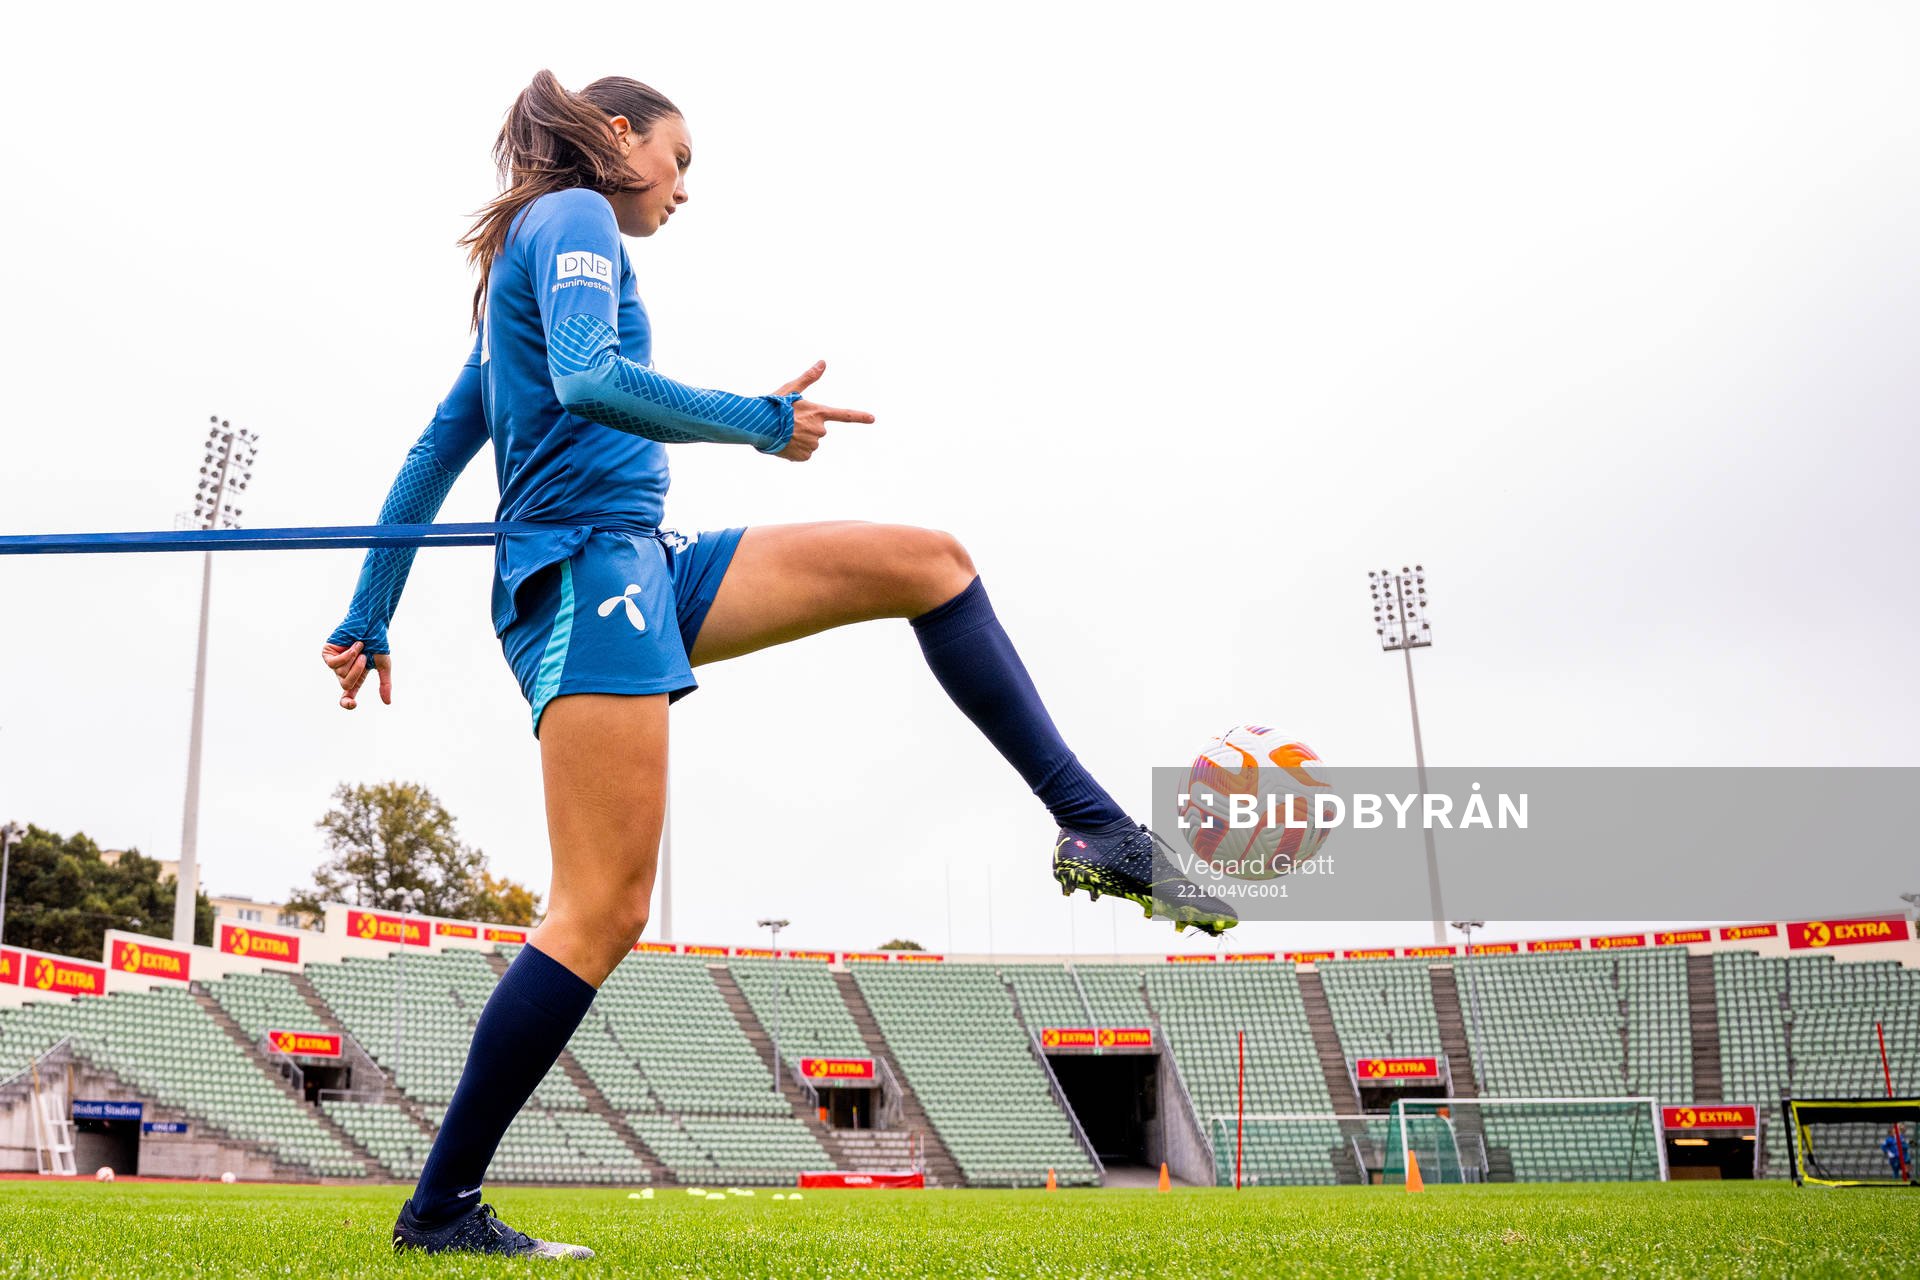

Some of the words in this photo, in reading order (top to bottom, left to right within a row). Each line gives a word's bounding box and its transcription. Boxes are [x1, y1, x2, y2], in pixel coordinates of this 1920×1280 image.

[565, 253, 607, 276] DNB
[379, 921, 420, 939] EXTRA
[1741, 926, 1771, 937] EXTRA
[1834, 922, 1891, 940] EXTRA
[1676, 932, 1704, 942] EXTRA
[251, 936, 290, 956] EXTRA
[142, 953, 180, 973] EXTRA
[56, 969, 96, 990] EXTRA
[297, 1037, 332, 1050] EXTRA
[1061, 1032, 1095, 1043] EXTRA
[1117, 1032, 1150, 1043] EXTRA
[829, 1063, 864, 1074] EXTRA
[1388, 1062, 1426, 1073] EXTRA
[1699, 1111, 1743, 1122] EXTRA
